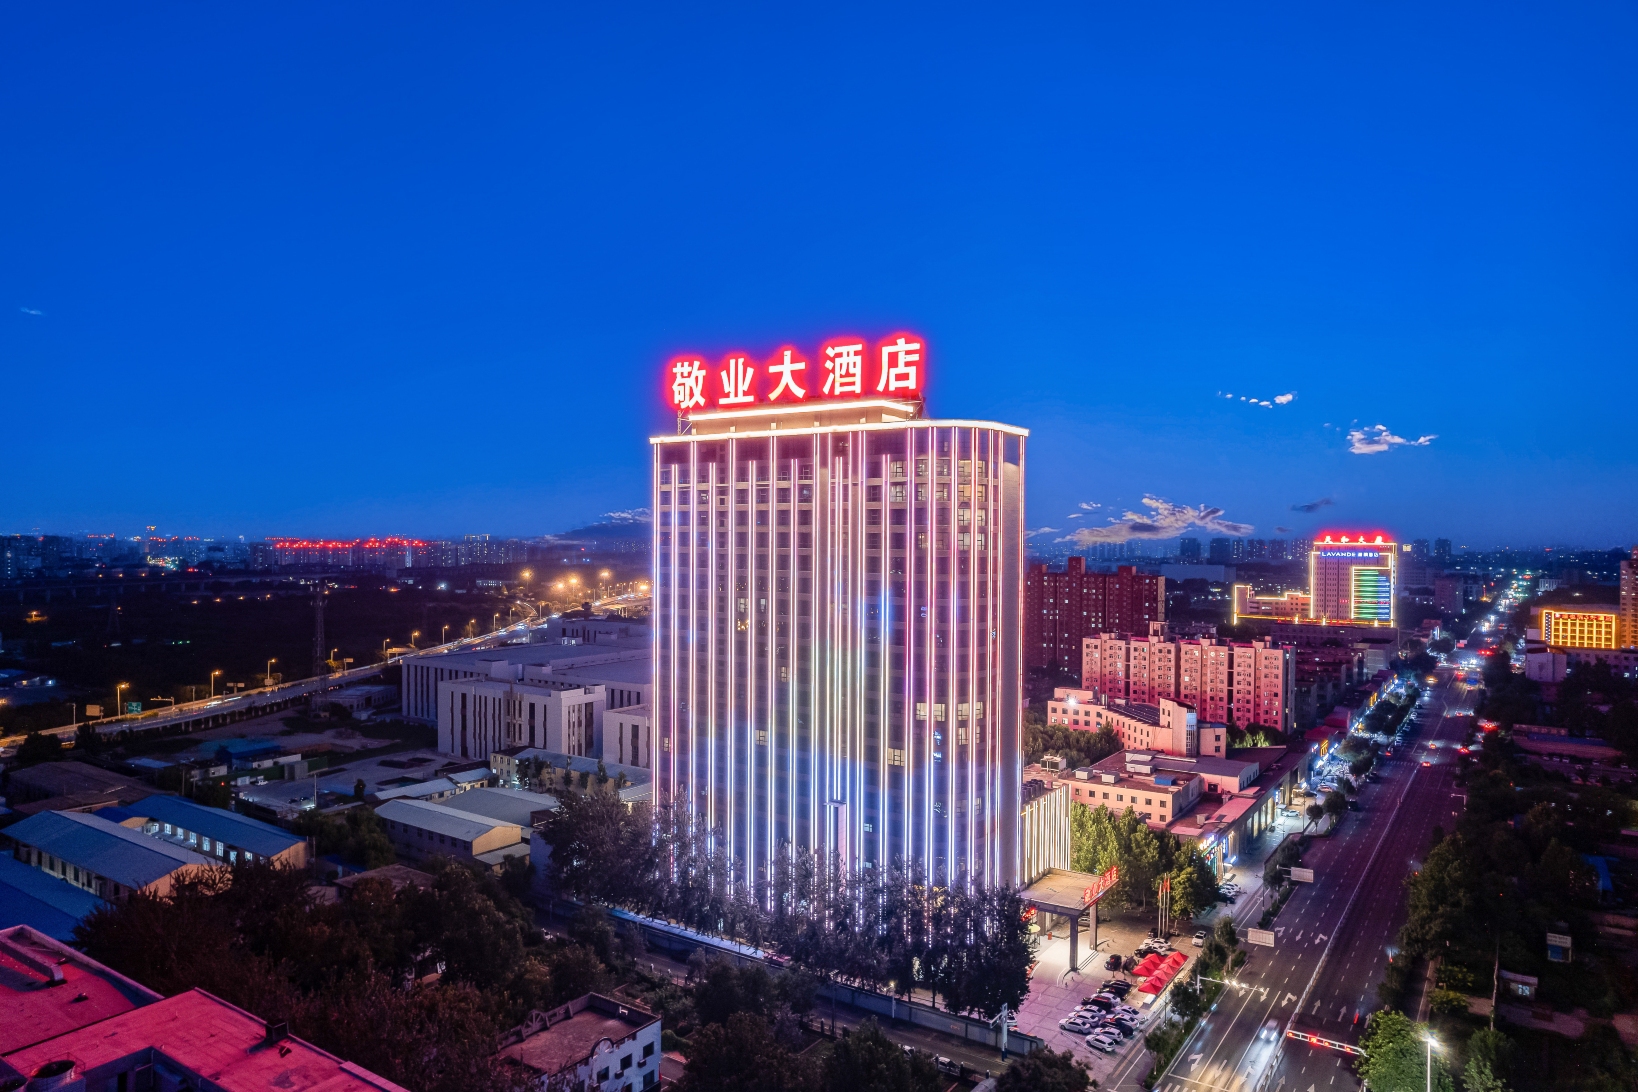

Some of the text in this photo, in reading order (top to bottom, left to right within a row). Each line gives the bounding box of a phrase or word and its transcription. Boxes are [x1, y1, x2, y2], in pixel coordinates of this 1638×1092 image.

[672, 338, 920, 409] 敬业大酒店
